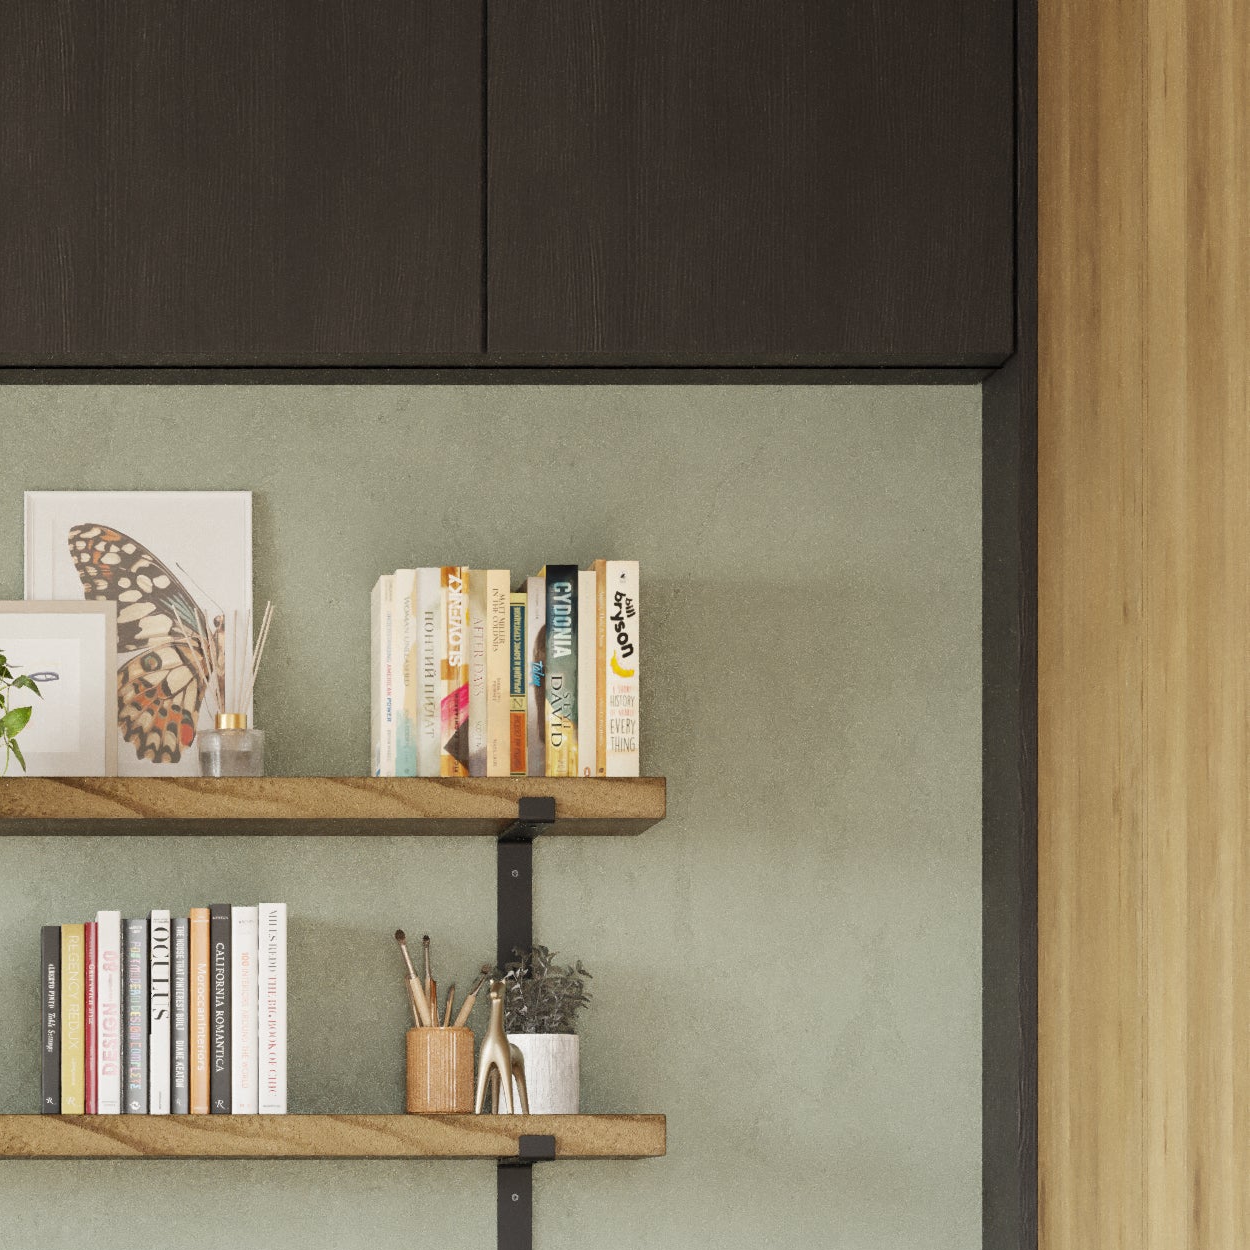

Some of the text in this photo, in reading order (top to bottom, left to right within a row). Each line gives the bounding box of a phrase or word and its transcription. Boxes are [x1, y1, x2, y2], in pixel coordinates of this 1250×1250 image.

[553, 581, 572, 658] CYDONIA
[610, 591, 634, 658] bryson
[625, 598, 636, 618] bill
[424, 611, 436, 738] ПОНТИЙ ПИЛАТ
[473, 616, 484, 697] AFTER DAYS
[550, 676, 563, 748] DAVID
[610, 718, 636, 735] EVERY
[610, 737, 636, 753] THING
[67, 935, 80, 1050] REGENCY REDUX
[152, 926, 169, 1021] OCULUS
[175, 926, 184, 1031] THE HOUSE THAT PINTEREST BUILT
[241, 951, 249, 966] 100
[268, 976, 277, 997] THE
[102, 950, 118, 1076] DESIGN 80
[215, 942, 225, 1072] CALIFORNIA ROMANTICA
[268, 1020, 277, 1050] BOOK
[175, 1040, 184, 1088] DIANE KEATON
